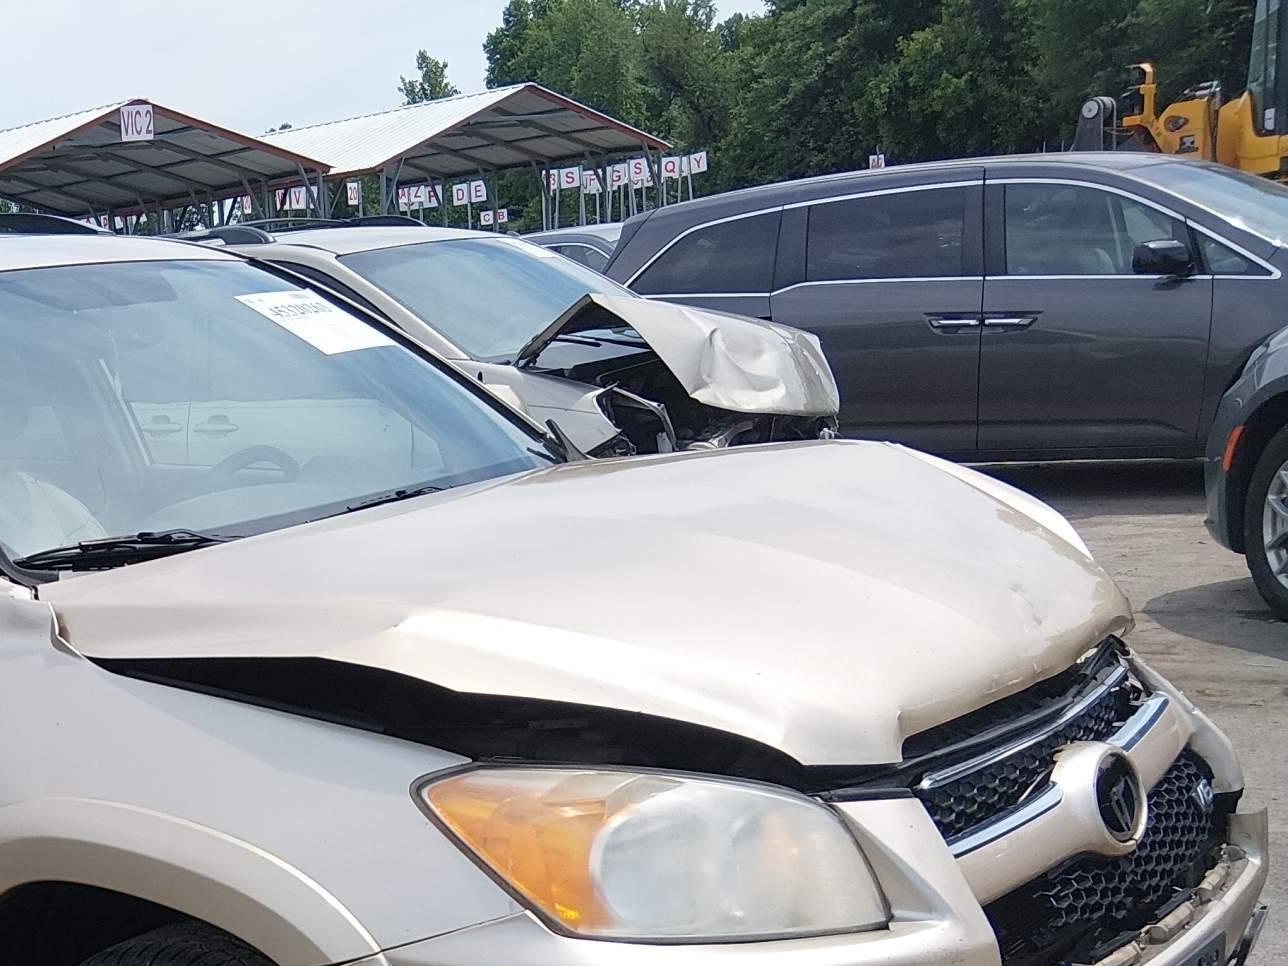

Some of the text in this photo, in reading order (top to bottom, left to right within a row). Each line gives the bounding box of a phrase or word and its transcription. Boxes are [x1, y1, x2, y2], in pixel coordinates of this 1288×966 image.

[121, 109, 154, 137] VIC 2
[634, 162, 643, 175] S
[664, 160, 676, 174] Q
[693, 155, 703, 169] Y
[565, 171, 575, 184] S
[611, 169, 621, 183] G
[293, 190, 302, 205] V
[456, 187, 465, 201] D
[474, 183, 483, 198] E
[483, 213, 491, 222] C
[496, 211, 504, 221] B
